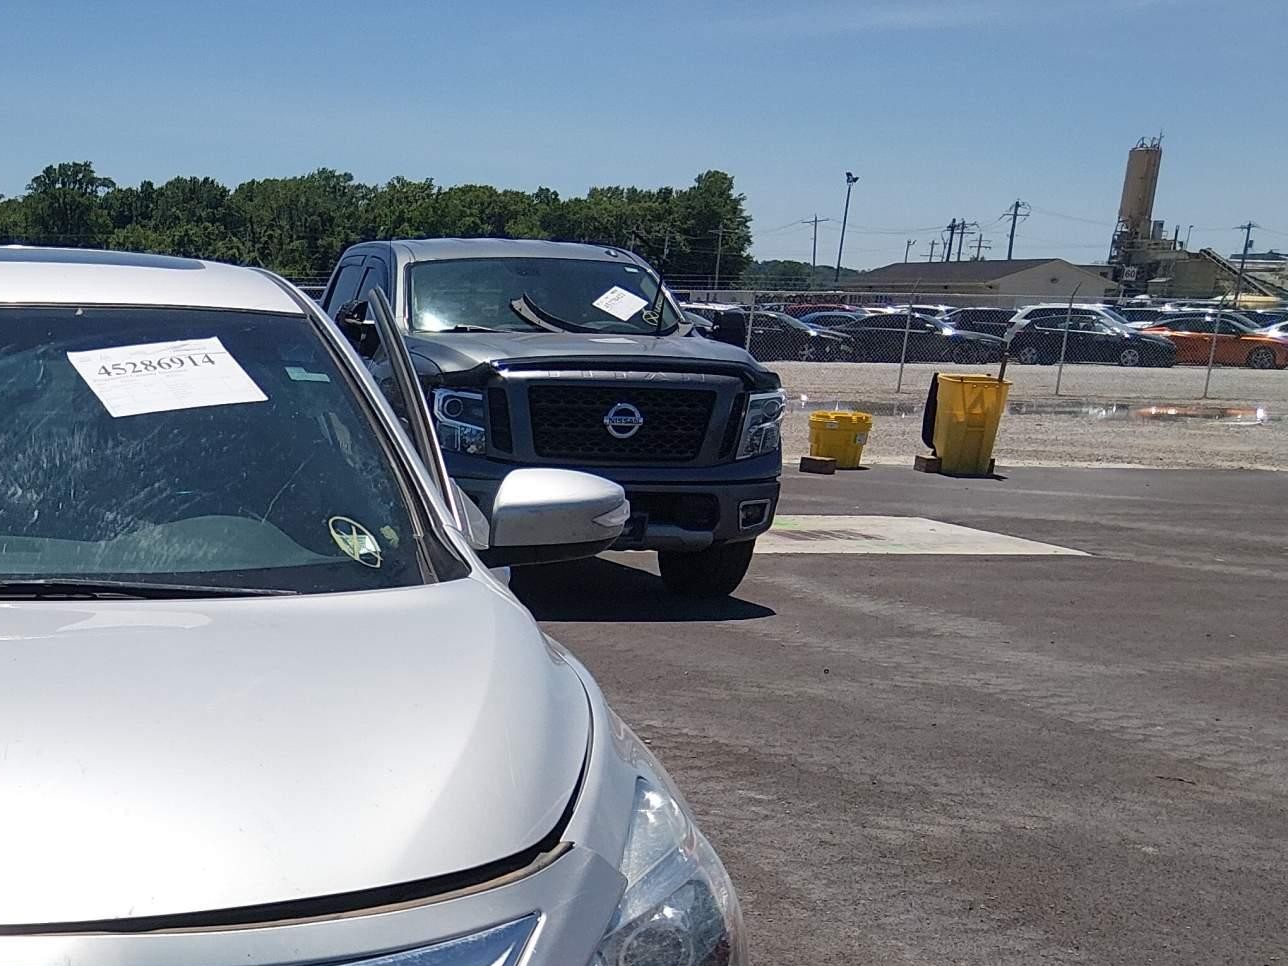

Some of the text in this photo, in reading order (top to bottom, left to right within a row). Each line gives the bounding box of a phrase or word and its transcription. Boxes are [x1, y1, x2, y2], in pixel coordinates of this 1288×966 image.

[1125, 269, 1136, 278] 60
[97, 353, 215, 377] 45286914
[607, 417, 640, 425] NISSAN
